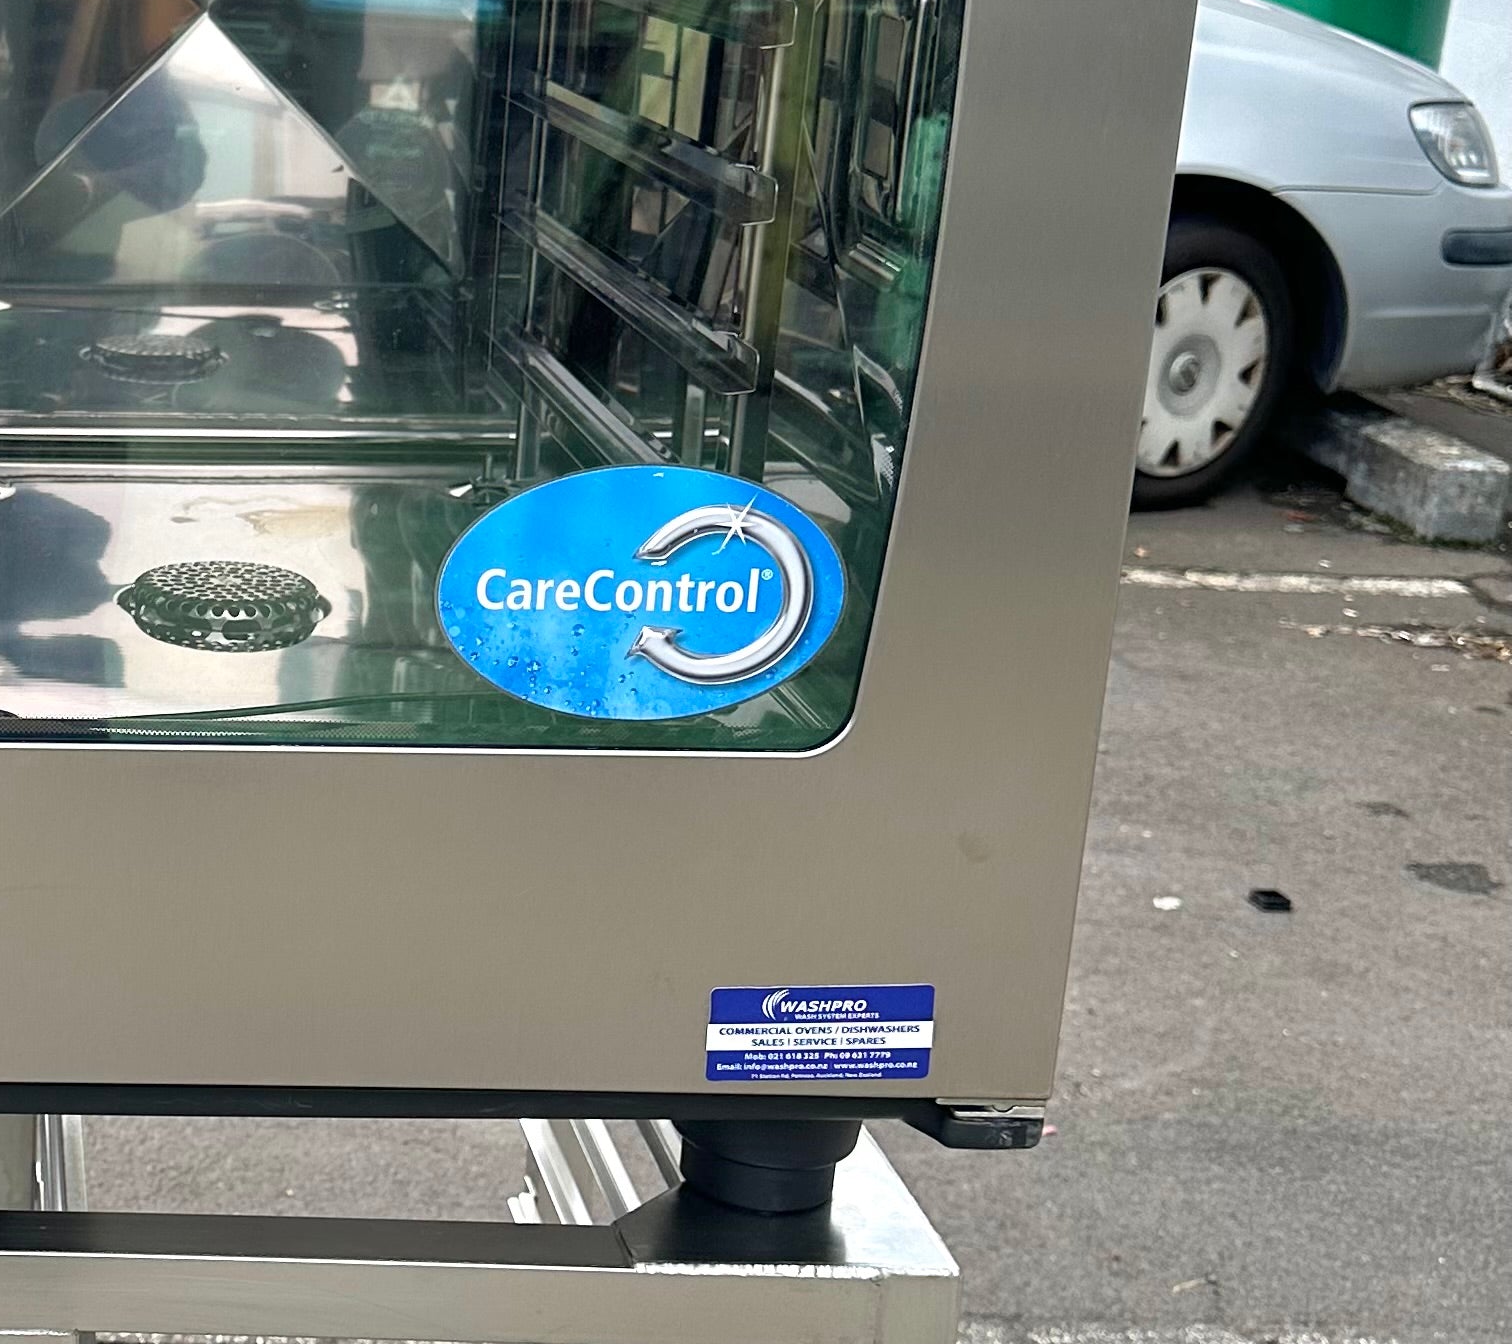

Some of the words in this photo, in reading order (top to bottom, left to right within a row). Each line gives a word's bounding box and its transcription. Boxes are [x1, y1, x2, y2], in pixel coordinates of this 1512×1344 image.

[780, 999, 868, 1013] WASHPRO
[817, 1012, 847, 1020] SYSTEM
[847, 1012, 880, 1020] EXPERTS
[719, 1027, 792, 1035] COMMERCIAL
[795, 1026, 832, 1034] OVENS
[841, 1025, 920, 1034] DISHWASHERS
[751, 1038, 785, 1046] SALES
[793, 1038, 837, 1046] SERVICE
[845, 1037, 886, 1045] SPARES
[744, 1052, 766, 1060] Mob:
[767, 1052, 783, 1060] 021
